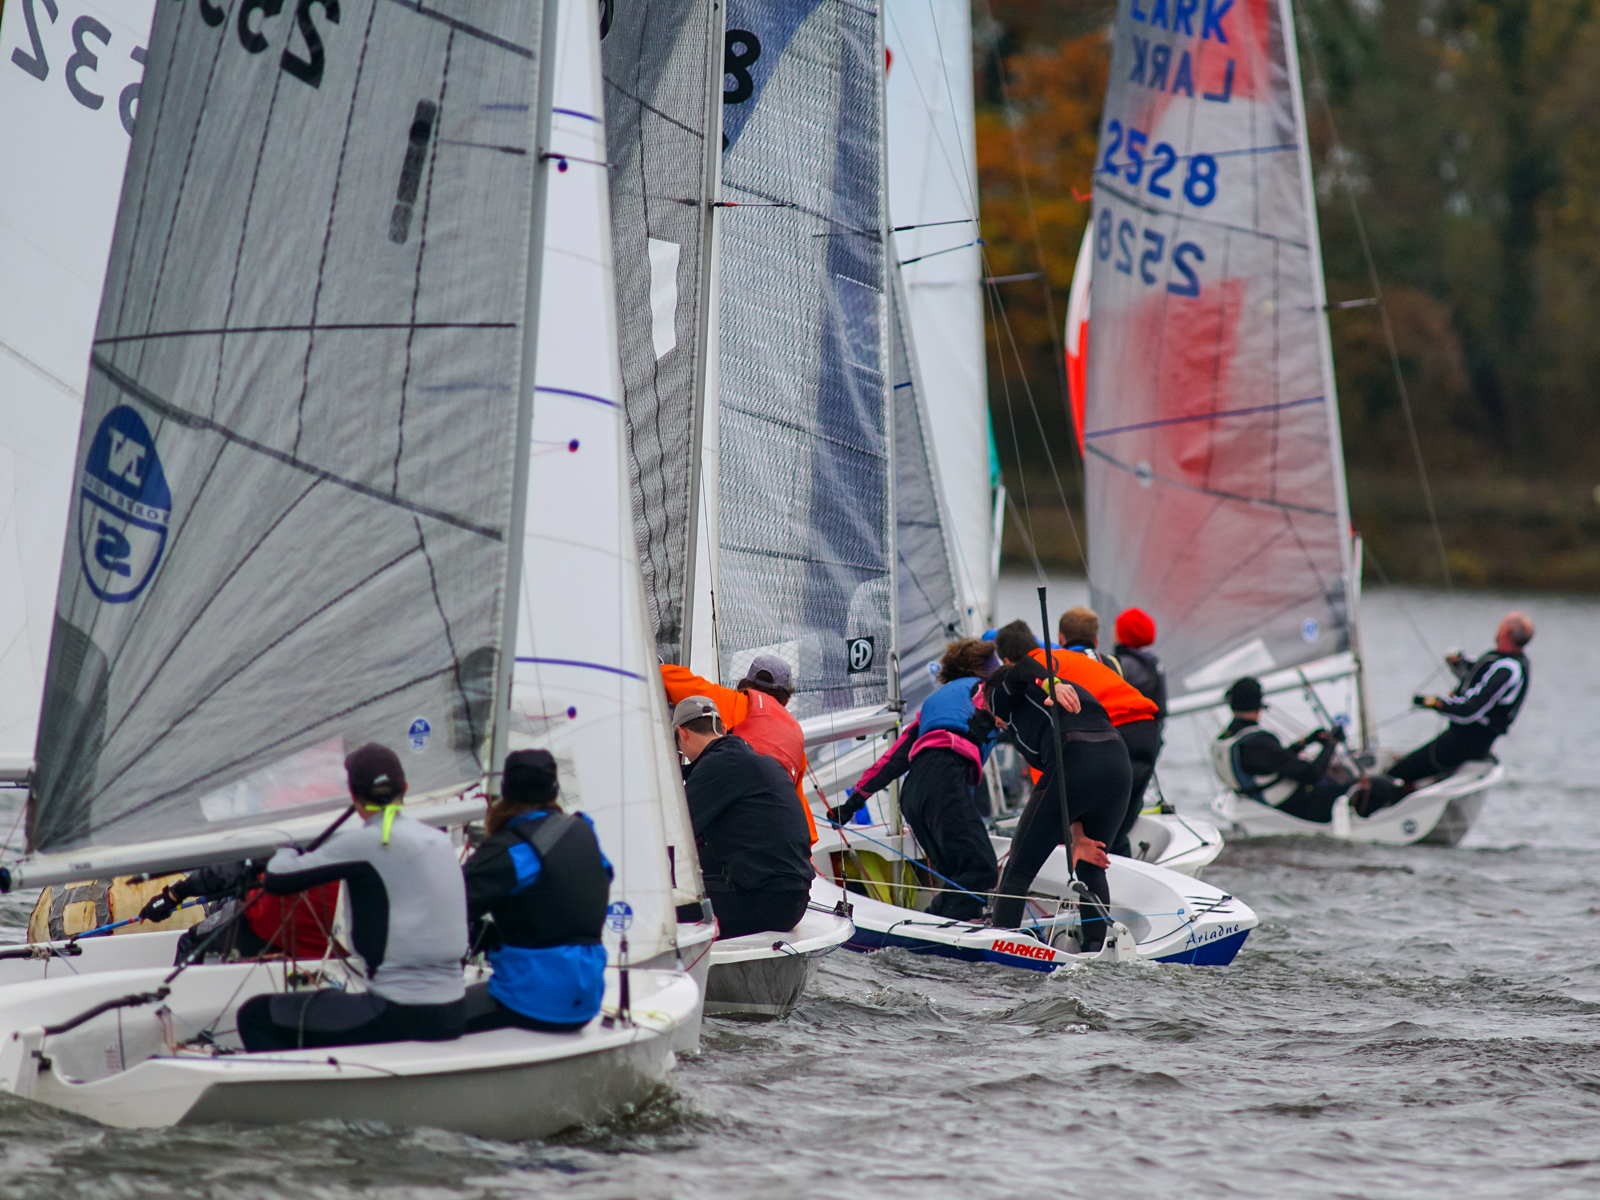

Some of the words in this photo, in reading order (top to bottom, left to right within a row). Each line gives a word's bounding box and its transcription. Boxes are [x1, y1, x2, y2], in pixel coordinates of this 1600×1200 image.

[1103, 119, 1218, 207] 2528
[612, 904, 627, 914] N
[1184, 923, 1240, 950] Ariadne
[991, 939, 1056, 962] HARKEN
